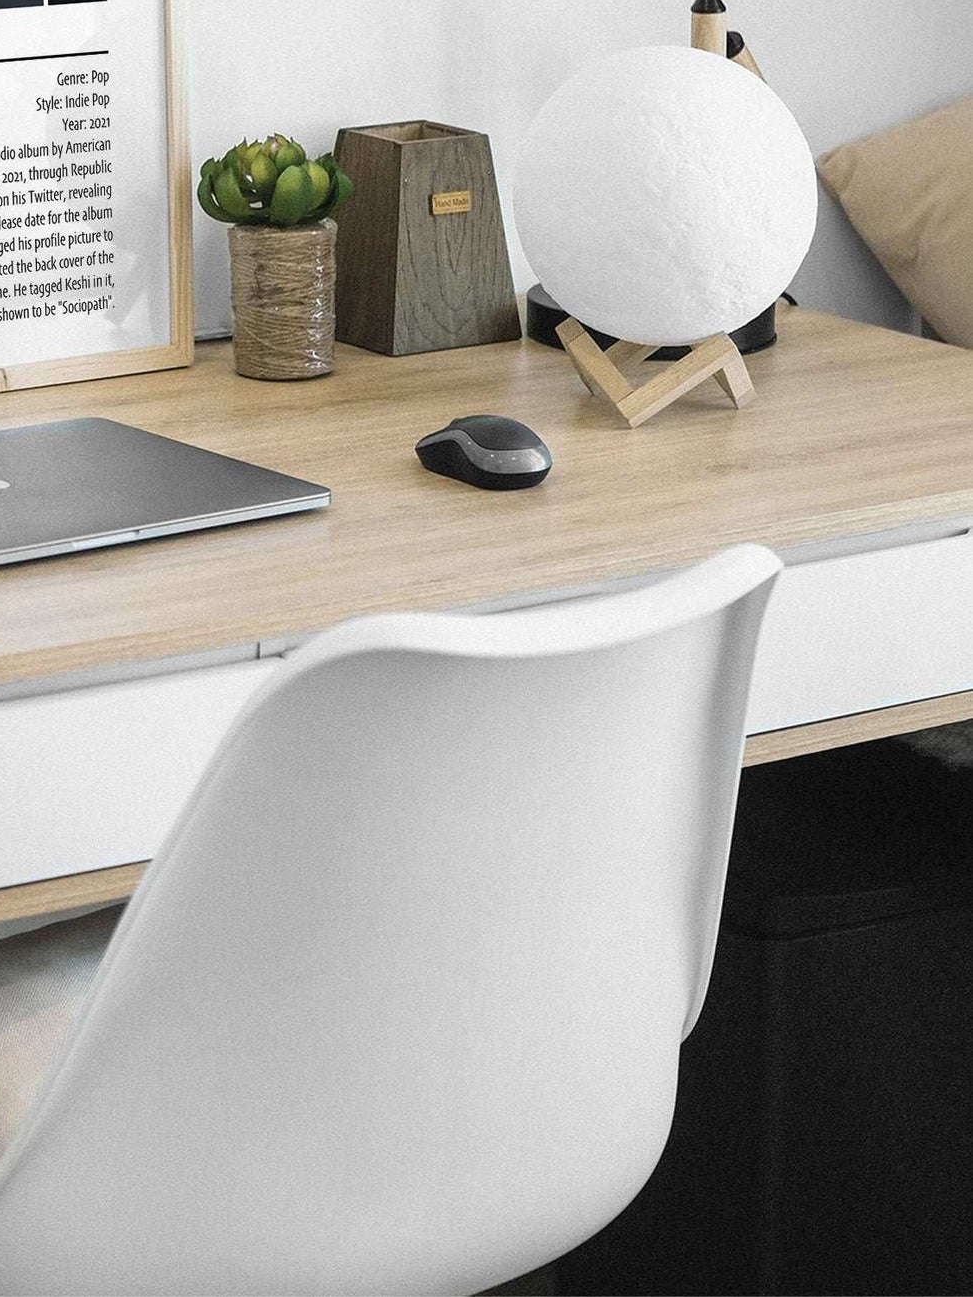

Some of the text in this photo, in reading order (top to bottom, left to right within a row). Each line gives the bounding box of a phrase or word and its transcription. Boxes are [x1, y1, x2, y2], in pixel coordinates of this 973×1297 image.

[57, 70, 110, 86] Genre: Pop
[36, 93, 110, 114] Style: Indie Pop
[62, 117, 110, 131] Year: 2021
[18, 143, 49, 159] album
[52, 141, 63, 159] by
[65, 138, 111, 154] American
[2, 171, 27, 184] 2021,
[28, 163, 68, 182] through
[71, 159, 112, 179] Republic
[12, 191, 26, 206] his
[28, 189, 66, 204] Twitter,
[68, 183, 112, 200] revealing
[18, 236, 32, 251] his
[34, 232, 66, 253] profile
[68, 231, 101, 249] picture
[103, 229, 113, 241] to
[16, 259, 33, 274] the
[35, 256, 57, 272] back
[59, 256, 85, 269] cover
[86, 251, 96, 266] of
[98, 250, 114, 264] the
[14, 283, 27, 297] He
[29, 277, 62, 298] tagged
[65, 275, 90, 291] Keshi
[93, 275, 102, 287] in
[105, 273, 115, 288] it,
[32, 305, 42, 318] to
[44, 302, 56, 317] be
[58, 295, 115, 315] "Sociopath".
